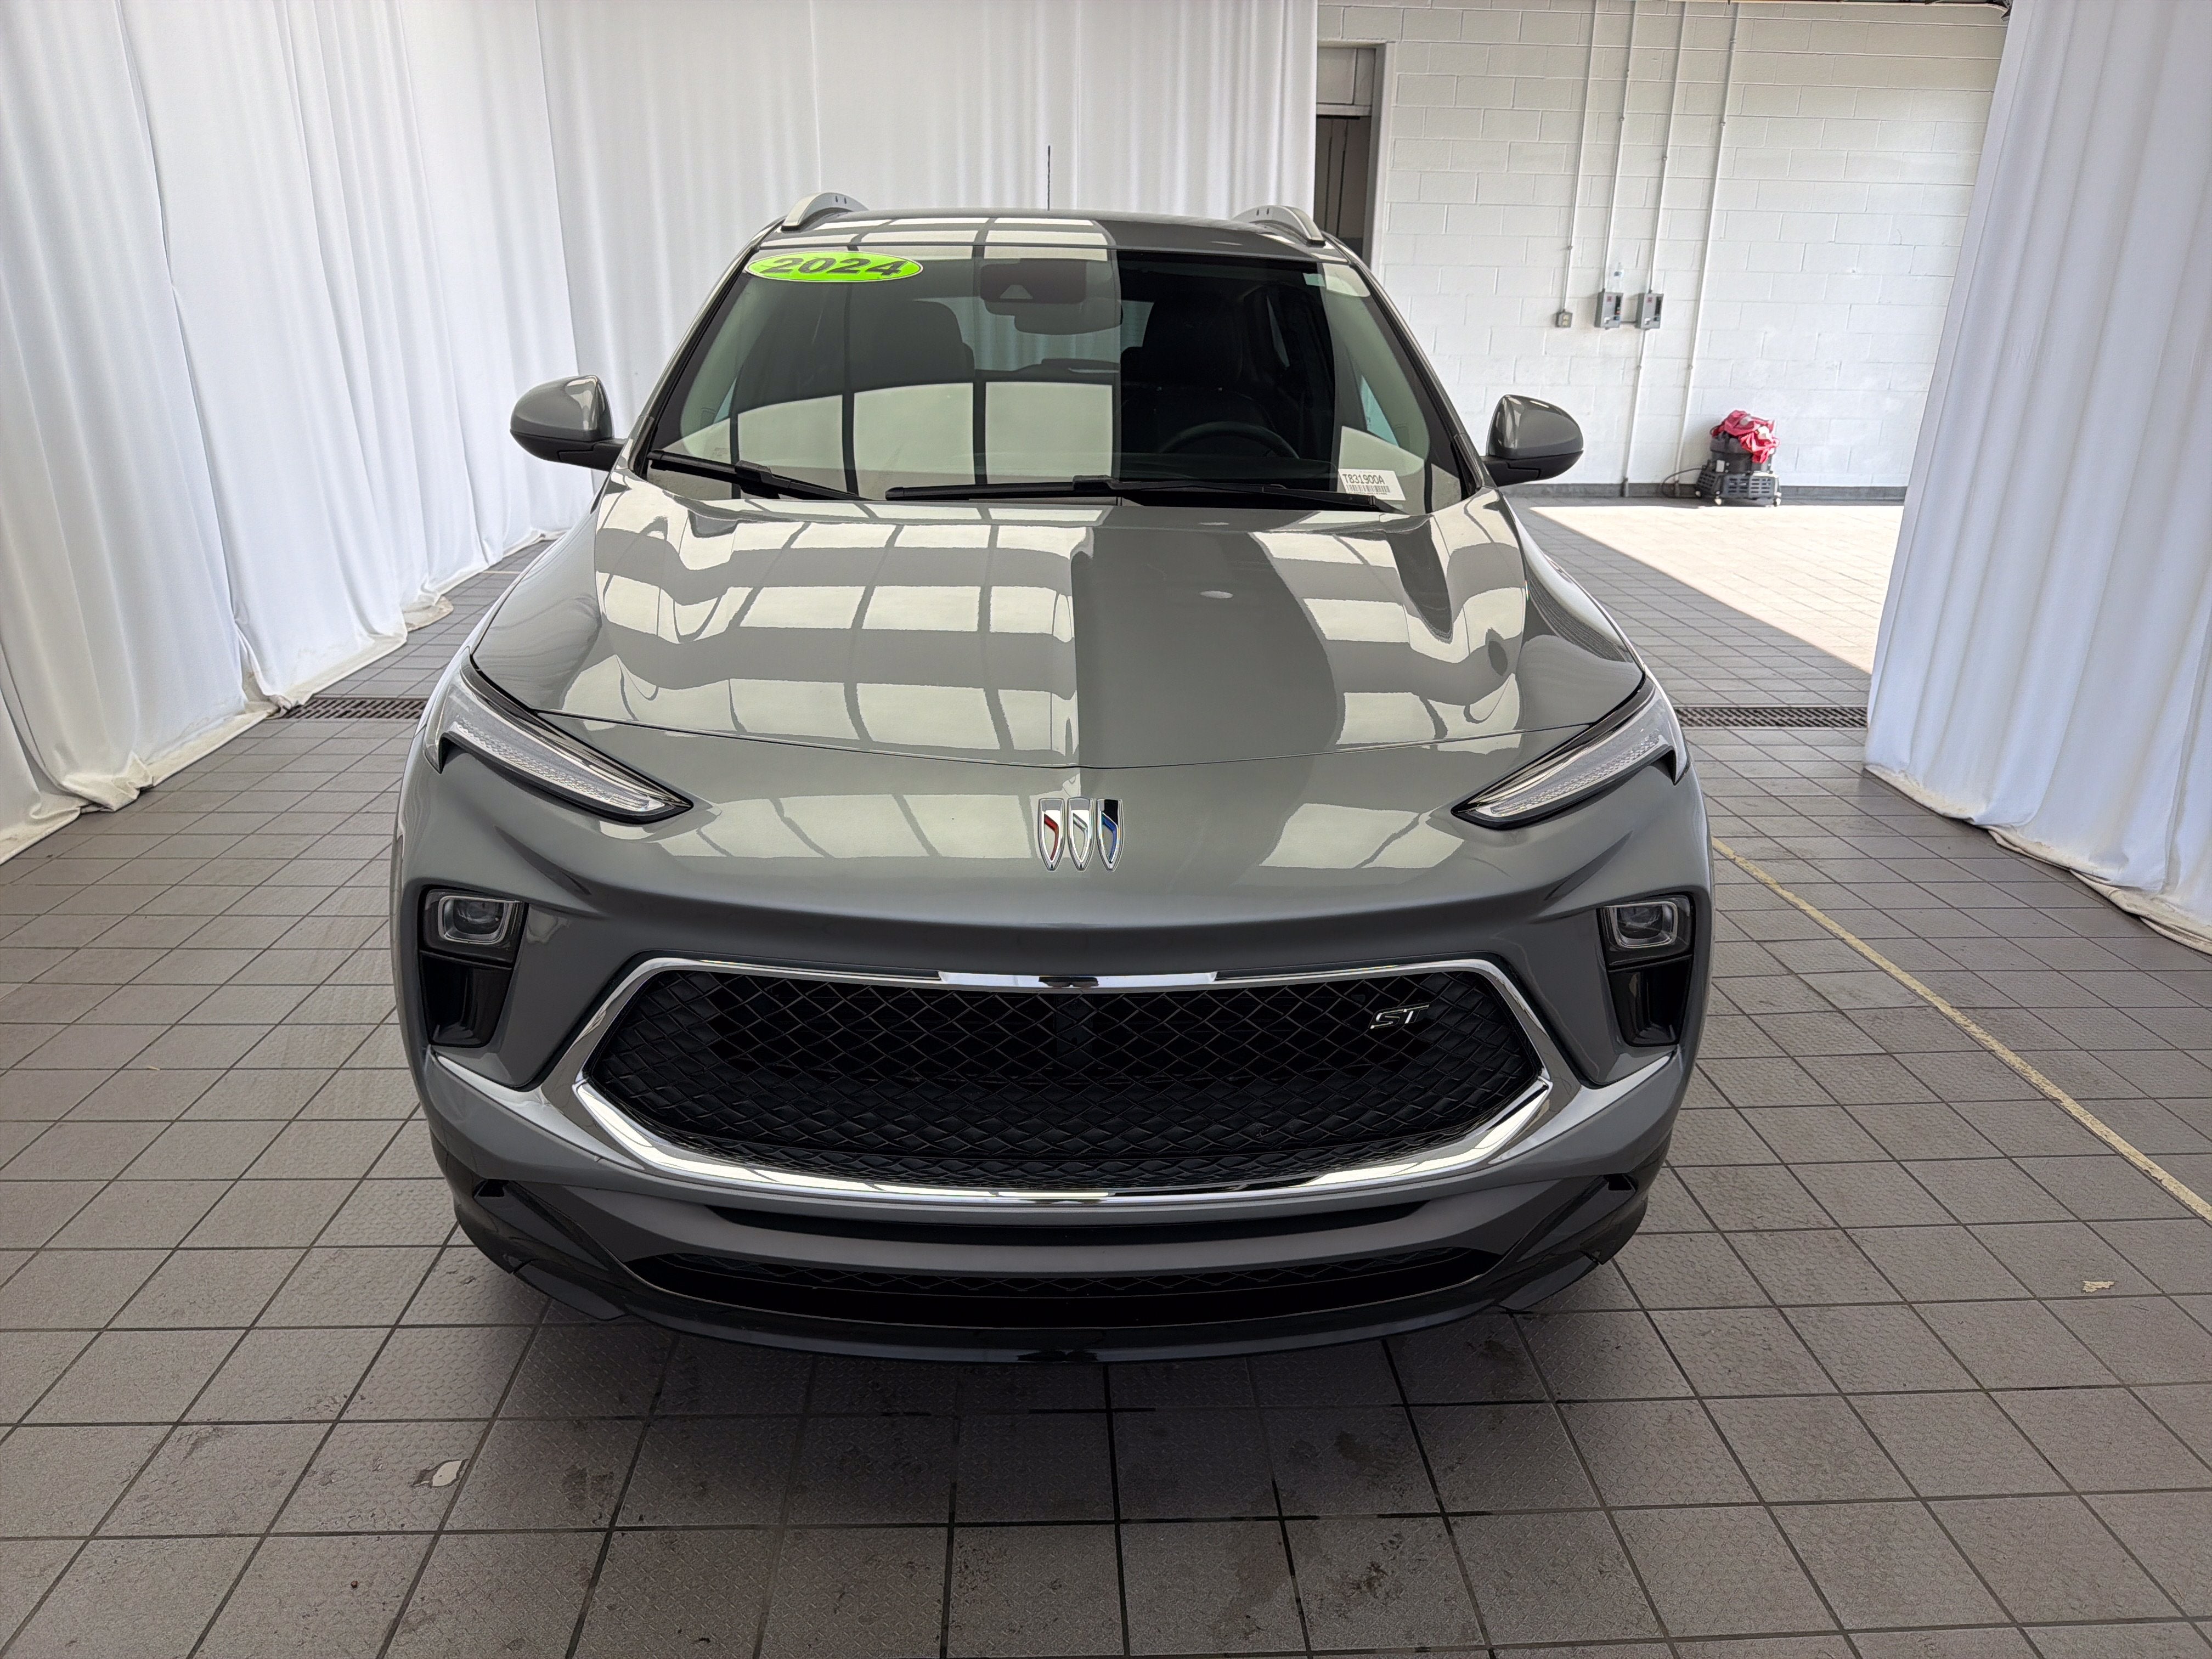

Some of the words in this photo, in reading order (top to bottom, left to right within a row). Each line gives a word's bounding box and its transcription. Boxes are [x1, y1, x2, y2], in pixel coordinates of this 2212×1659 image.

[759, 257, 909, 276] 2024
[1342, 473, 1385, 484] T831900A
[1369, 1003, 1430, 1029] ST
